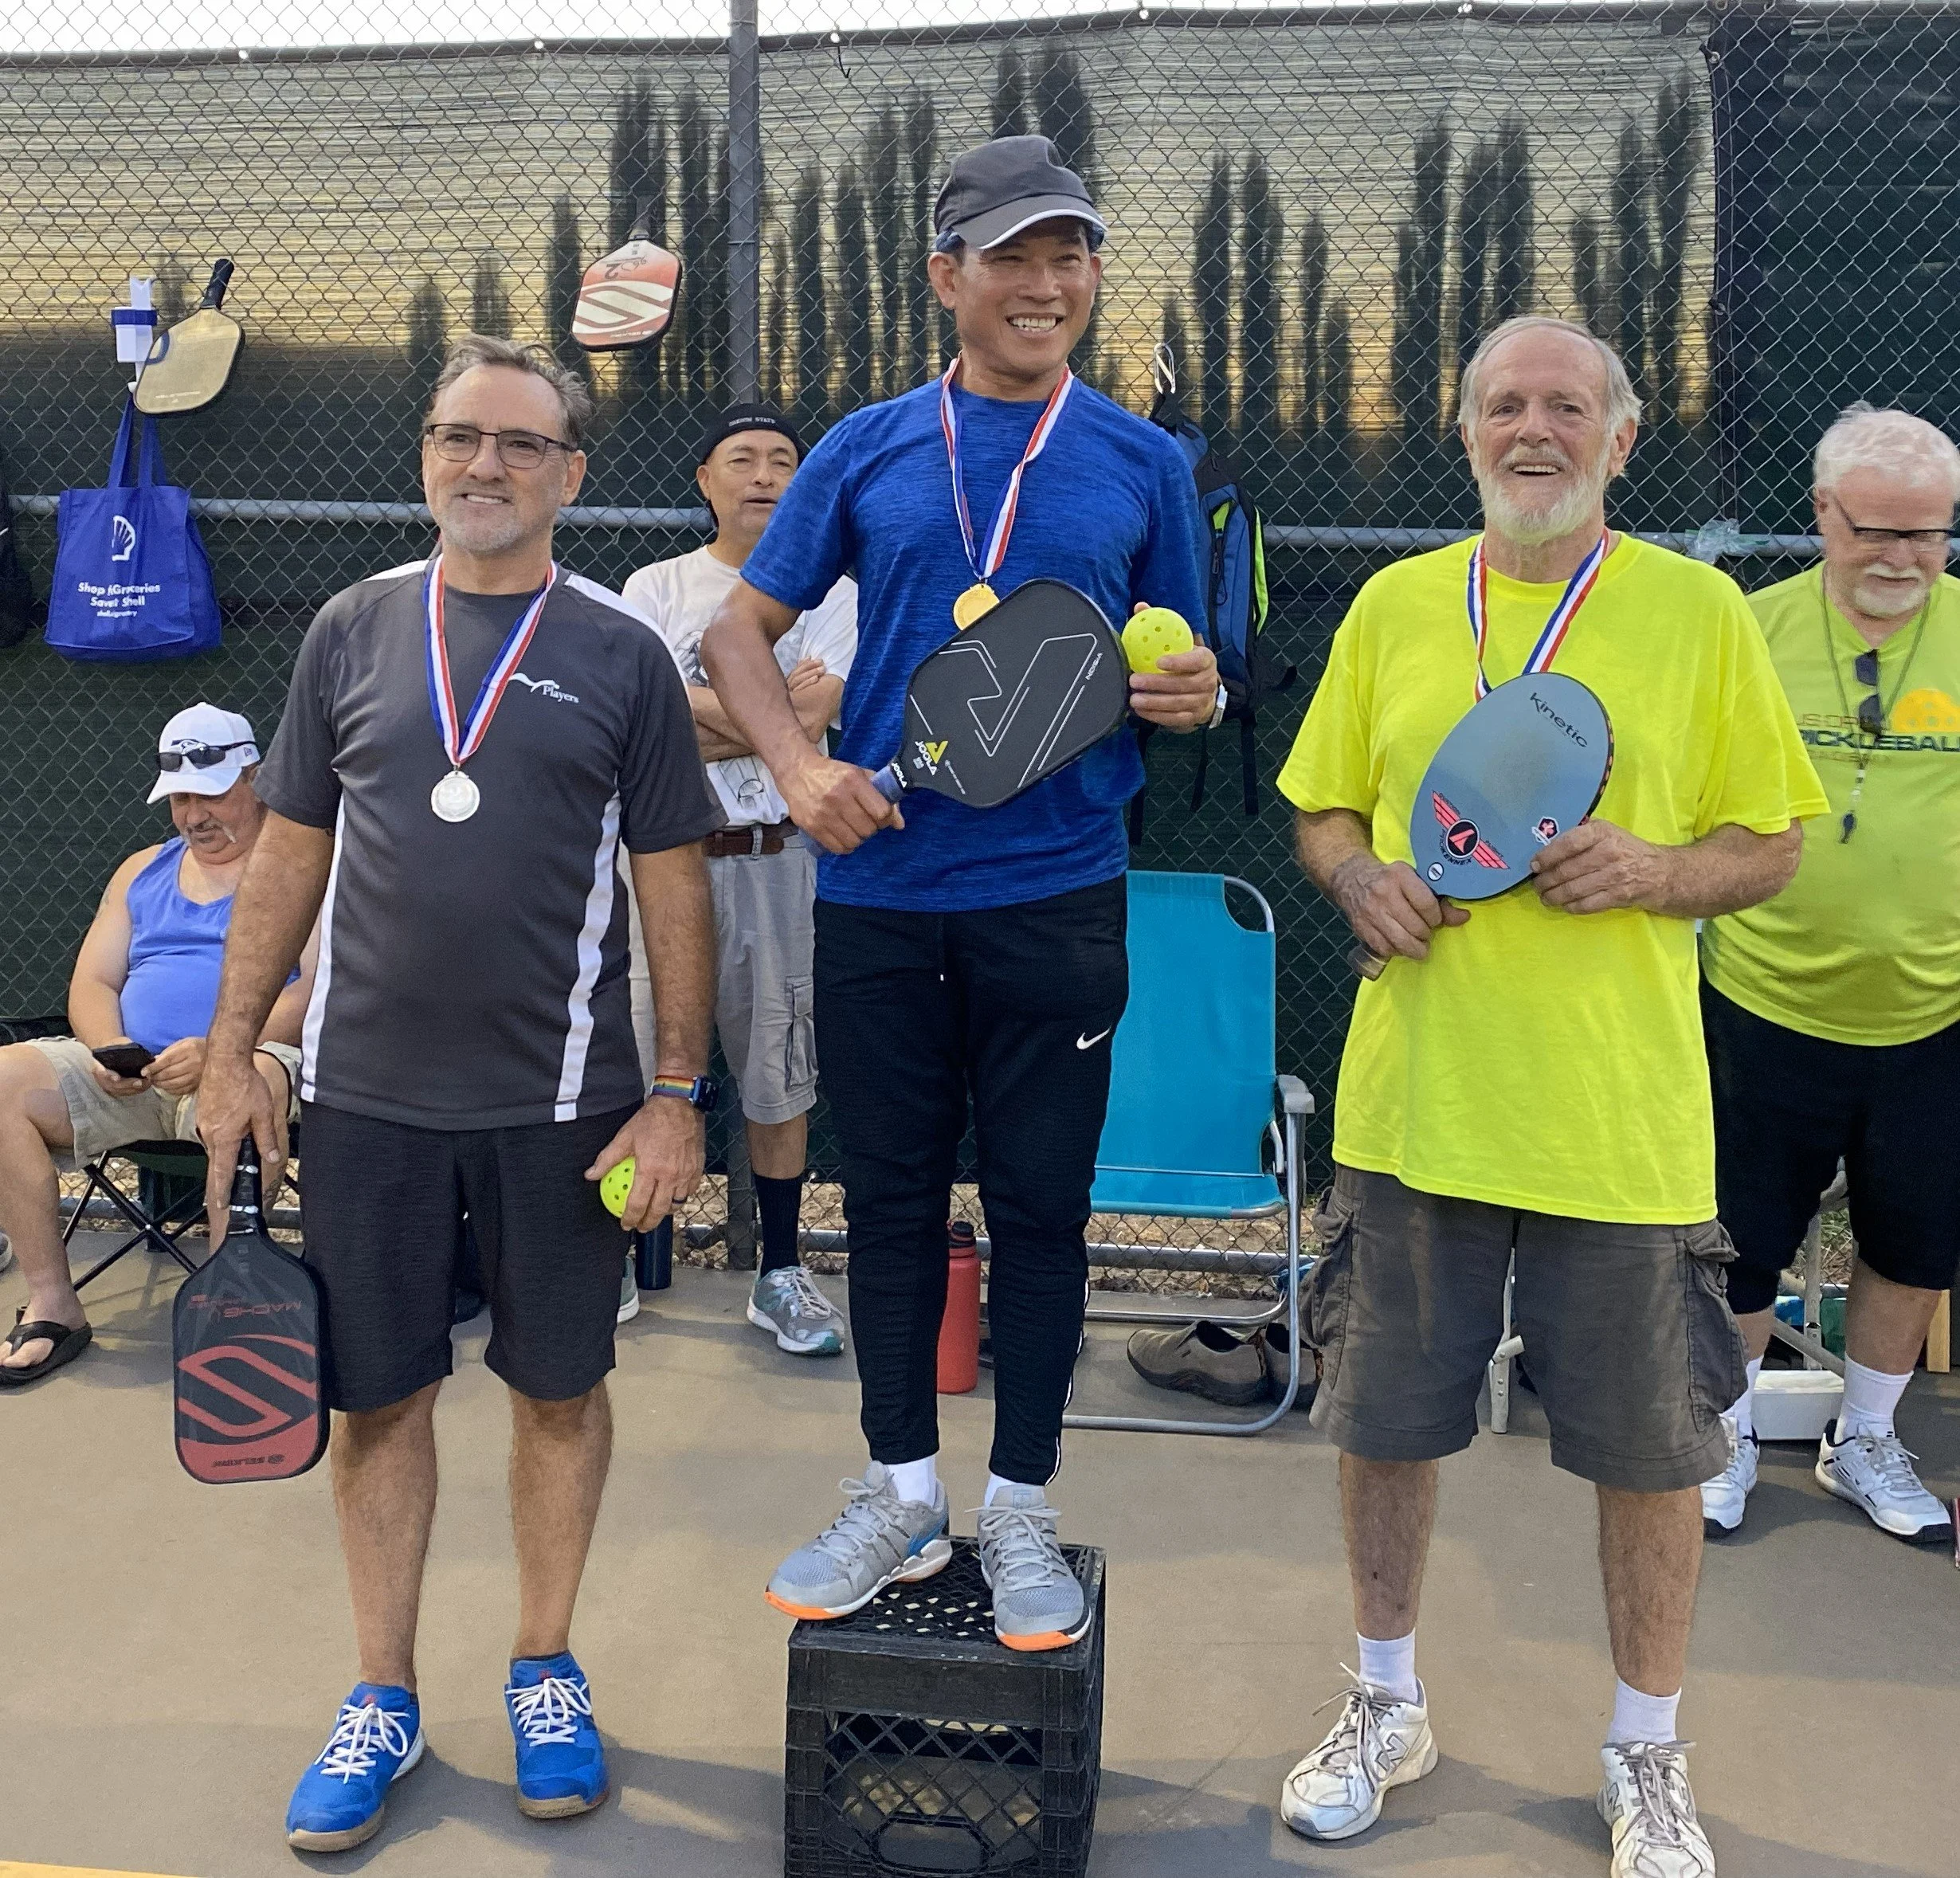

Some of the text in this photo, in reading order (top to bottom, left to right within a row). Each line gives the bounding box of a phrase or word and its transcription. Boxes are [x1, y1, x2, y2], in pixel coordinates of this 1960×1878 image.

[78, 582, 106, 596] Shop
[543, 685, 579, 704] Players
[1530, 692, 1588, 748] kinetic
[915, 740, 938, 776] JOOLA
[891, 763, 907, 788] JOOLA
